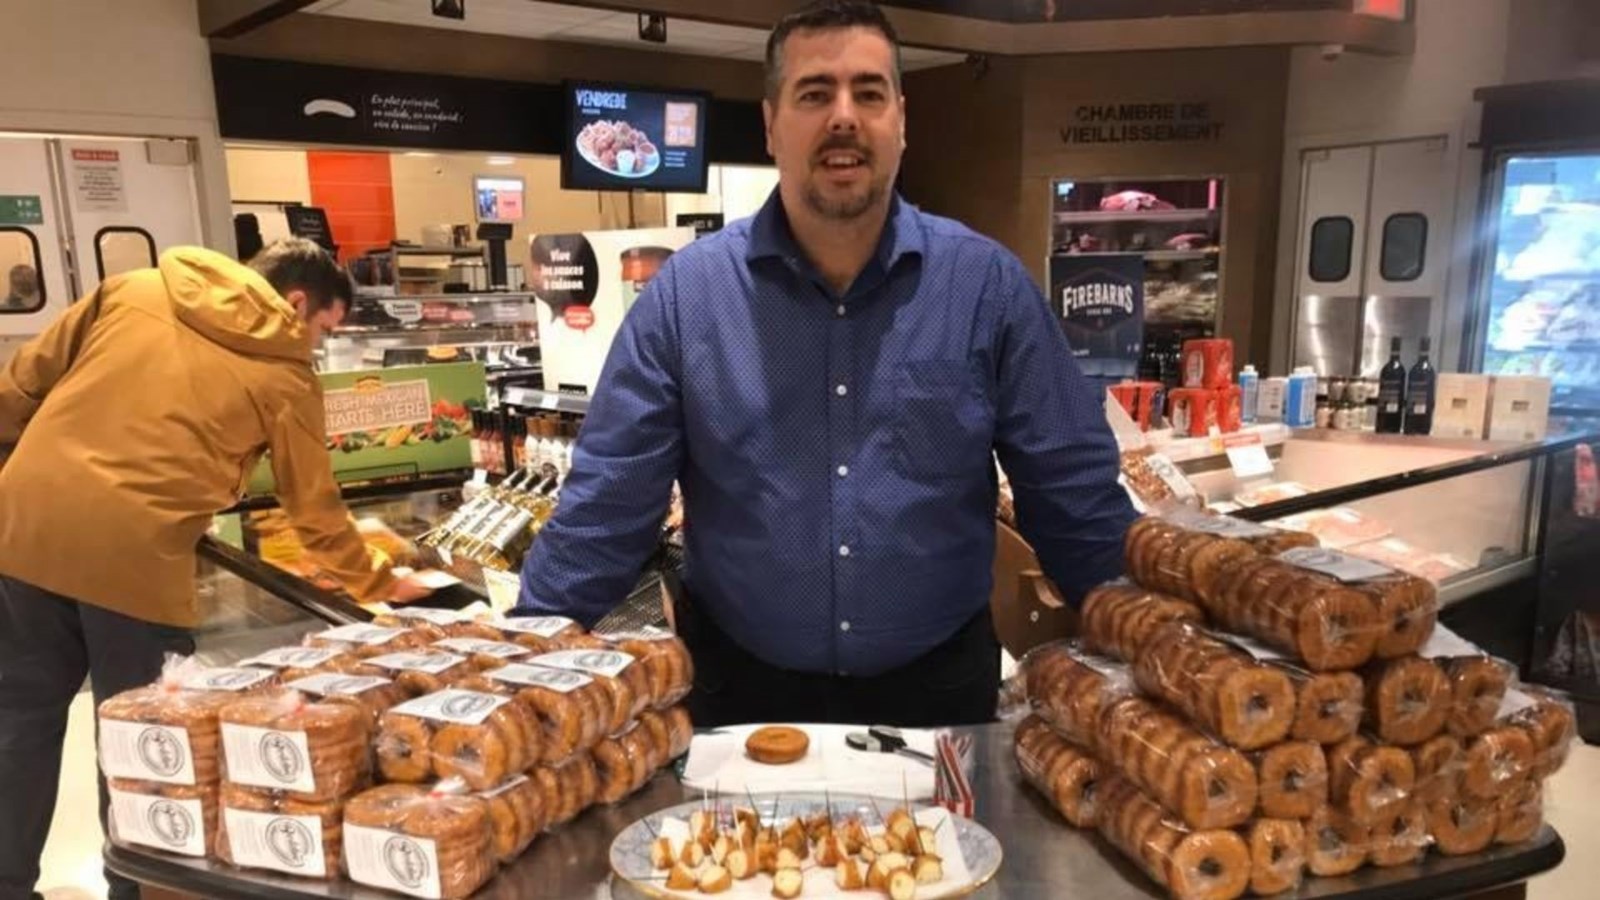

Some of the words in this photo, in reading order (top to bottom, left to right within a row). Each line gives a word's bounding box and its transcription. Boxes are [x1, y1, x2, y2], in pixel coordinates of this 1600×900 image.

[1076, 103, 1174, 122] CHAMBRE
[1180, 102, 1210, 121] DE
[1059, 122, 1225, 144] VIEILLISSEMENT
[550, 248, 571, 262] Vive
[554, 264, 584, 277] sauces
[1063, 283, 1134, 318] FIREBARNS
[325, 399, 360, 412] RESH
[365, 386, 424, 406] MEXICAN
[325, 408, 373, 428] TARTS
[382, 401, 425, 420] HERE
